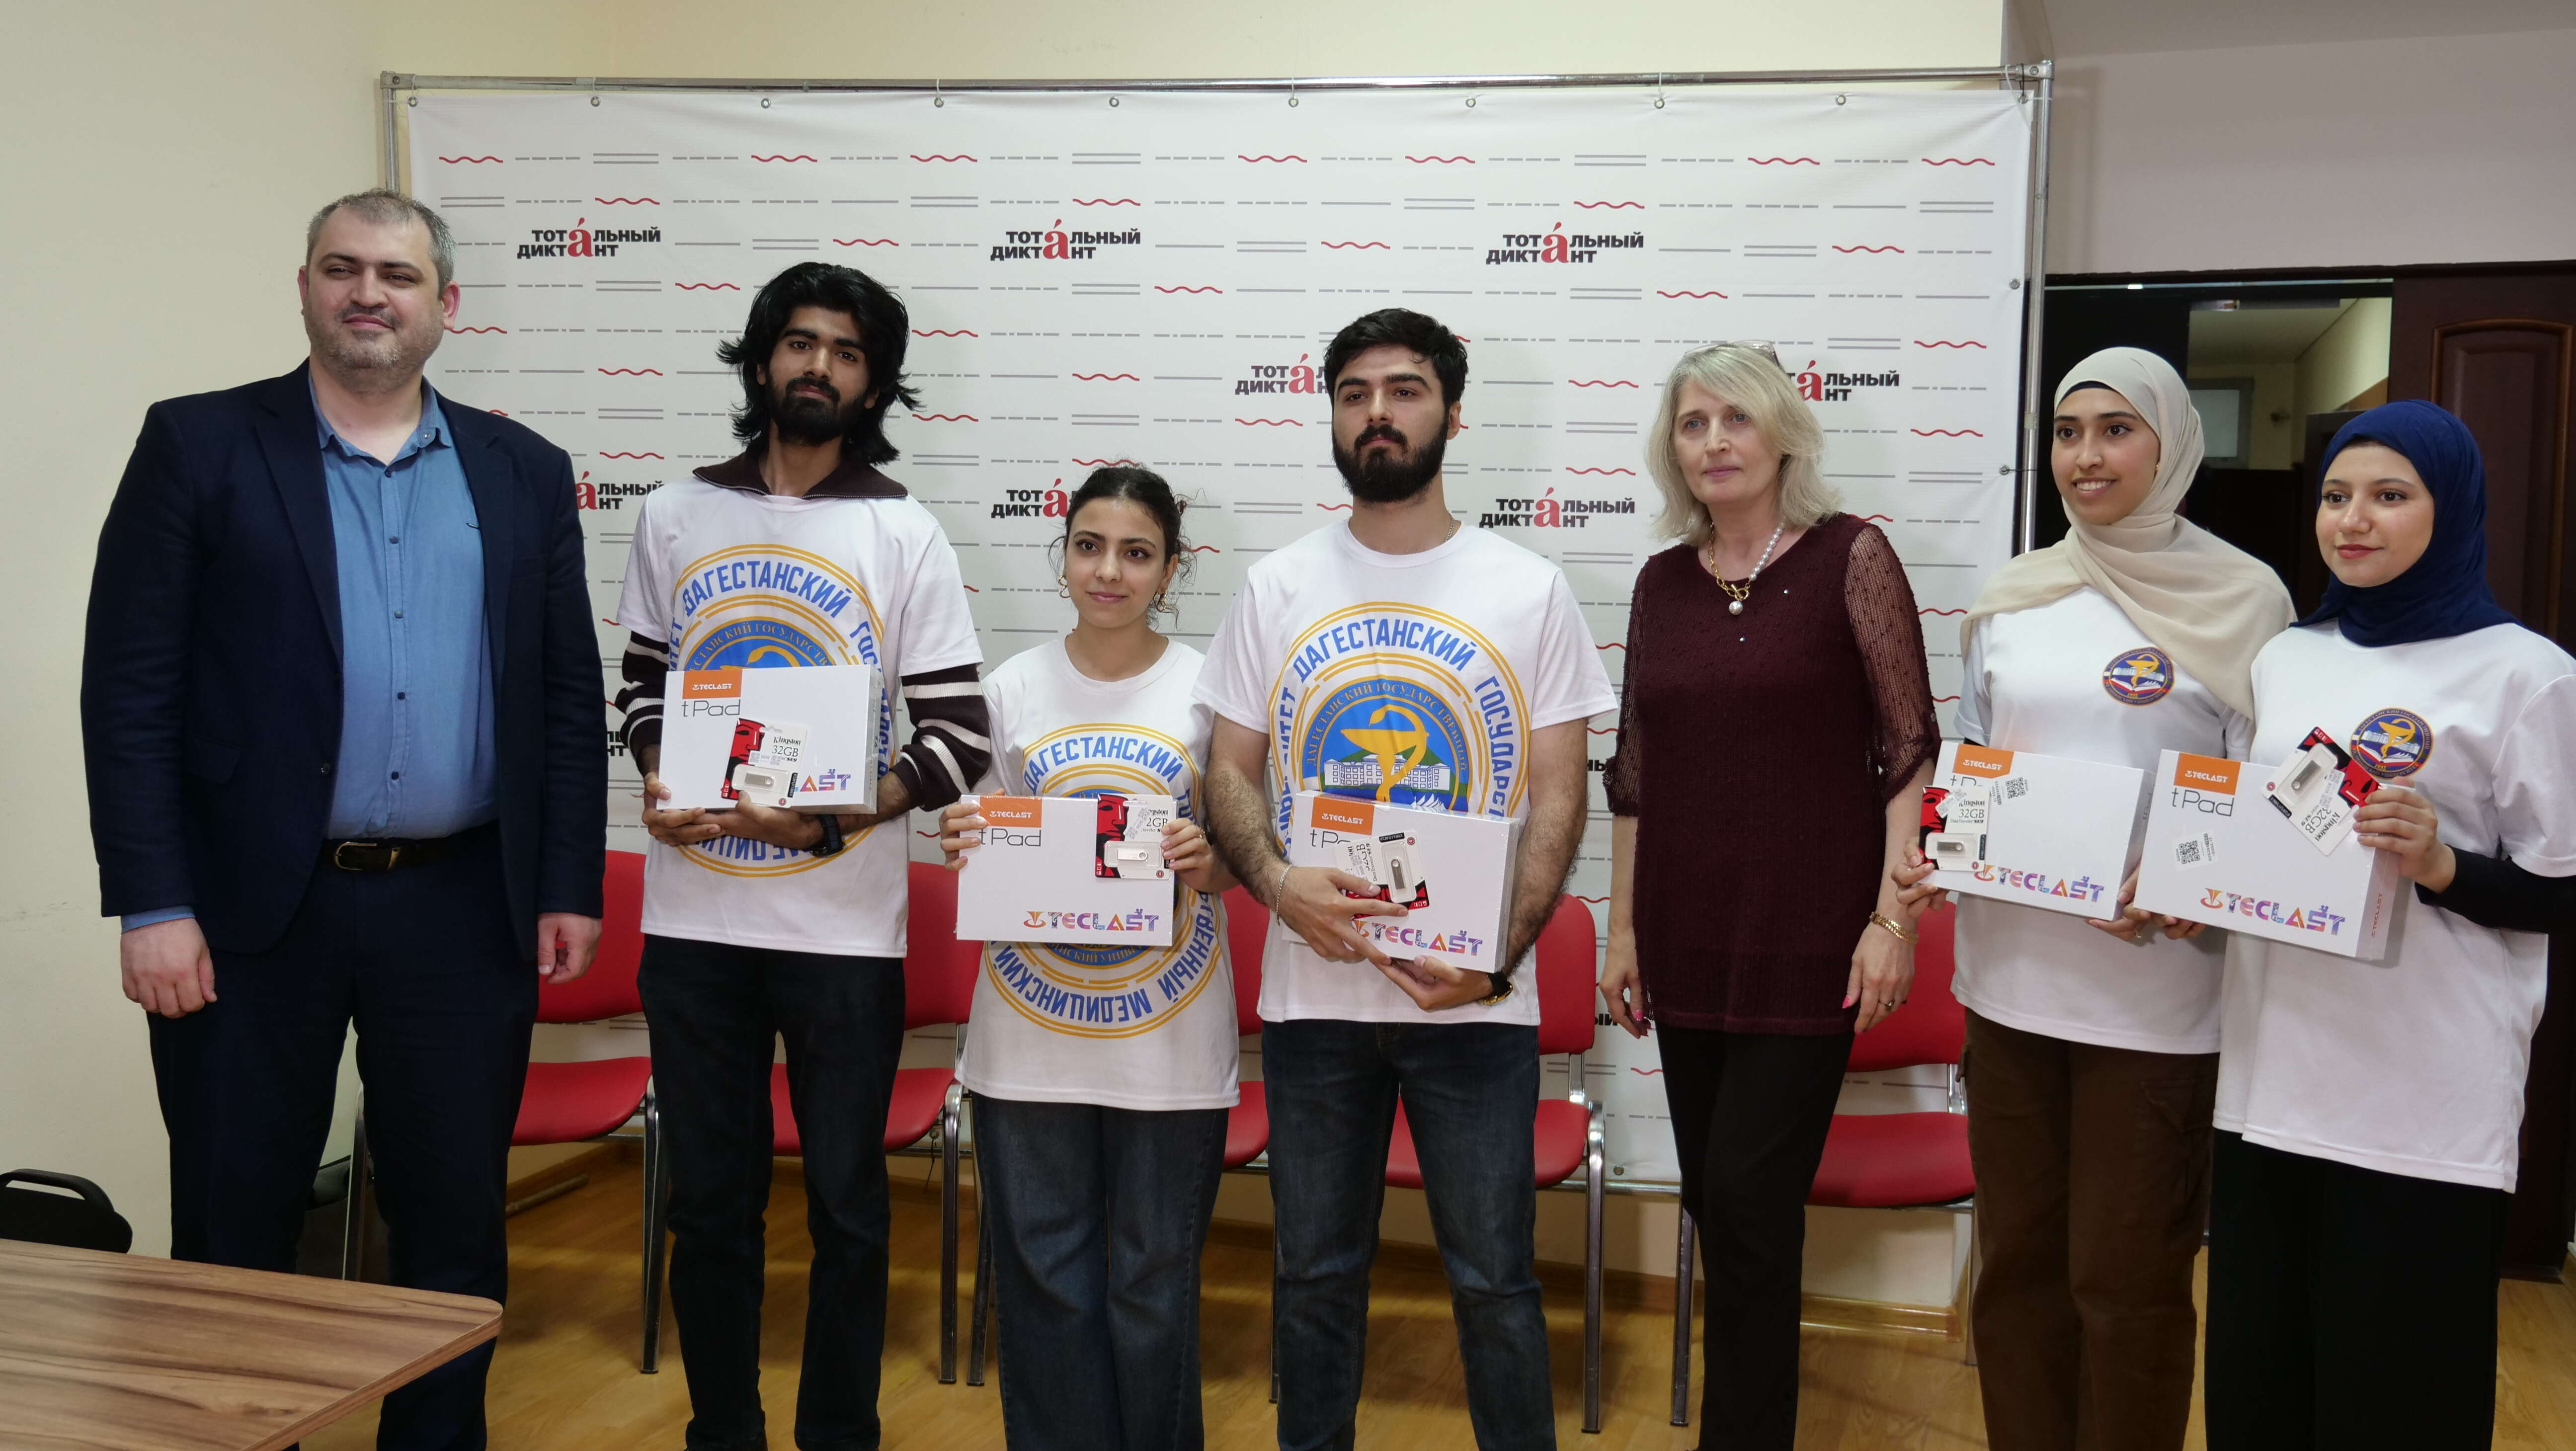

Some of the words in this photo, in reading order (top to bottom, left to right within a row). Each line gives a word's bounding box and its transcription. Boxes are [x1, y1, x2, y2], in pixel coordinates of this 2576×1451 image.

[683, 561, 853, 618] ДАГЕСТАНСКИЙ
[690, 623, 751, 671] СТАНСКИЙ
[755, 623, 829, 666] ГОСУДАРСТВ
[1293, 619, 1476, 683] ДАГЕСТАНСКИЙ
[1474, 676, 1514, 817] ГОСУДАРСТ
[1307, 683, 1372, 767] ДАГЕСТАНСКИЙ
[772, 745, 799, 757] 32GB
[773, 736, 801, 745] Kingston
[1024, 736, 1184, 796] ДАГЕСТАНСКИЙ
[1970, 760, 2002, 770] TECLAST
[2192, 771, 2228, 784] TECLAST
[1146, 817, 1168, 827] 2GB
[1329, 814, 1364, 825] TECLAST
[1959, 808, 1984, 819] 32GB
[2315, 812, 2340, 841] Kingston
[1998, 867, 2104, 902] TECLAST
[1047, 909, 1159, 932] TECLAST
[2226, 892, 2346, 936] TECLAST
[1371, 923, 1483, 956] TECLAST
[993, 945, 1153, 1023] МЕДИЦИНСКИЙ
